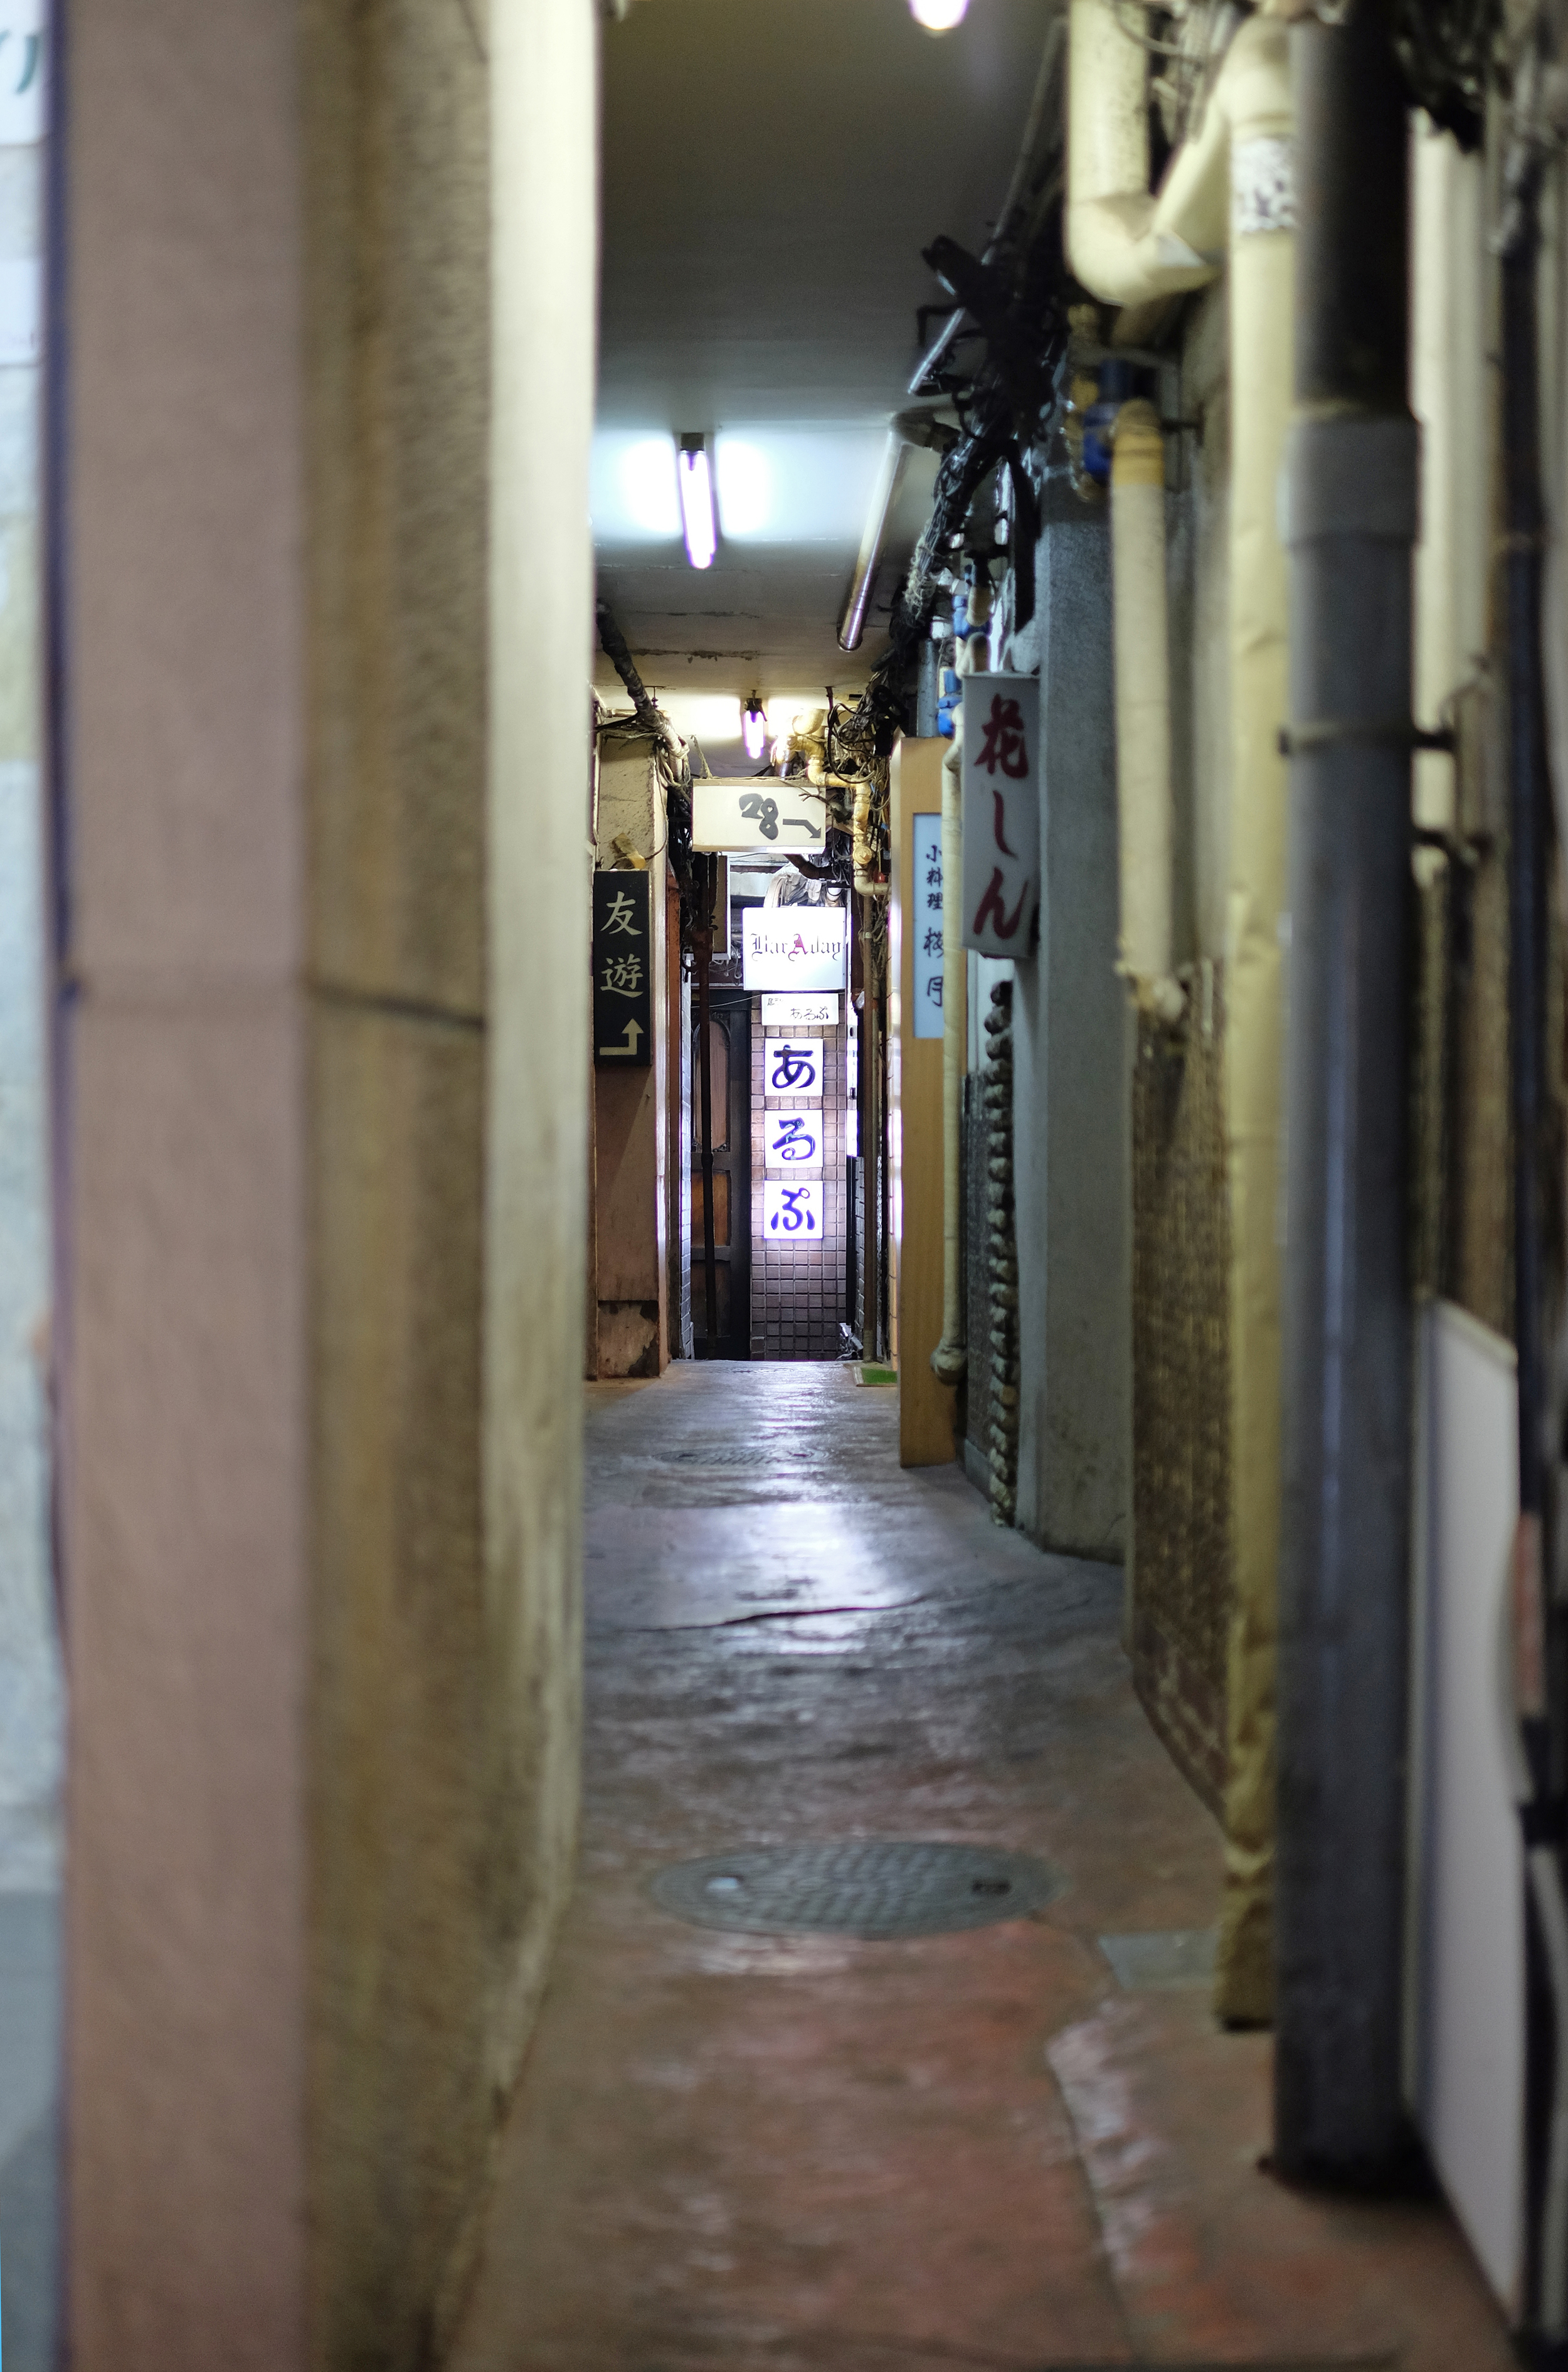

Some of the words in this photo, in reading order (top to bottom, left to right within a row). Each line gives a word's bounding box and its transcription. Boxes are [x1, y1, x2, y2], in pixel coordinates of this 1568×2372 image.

[739, 793, 779, 841] 28
[973, 693, 1029, 940] 花しん
[600, 891, 644, 999] 友遊
[771, 1044, 816, 1231] あるぷ
